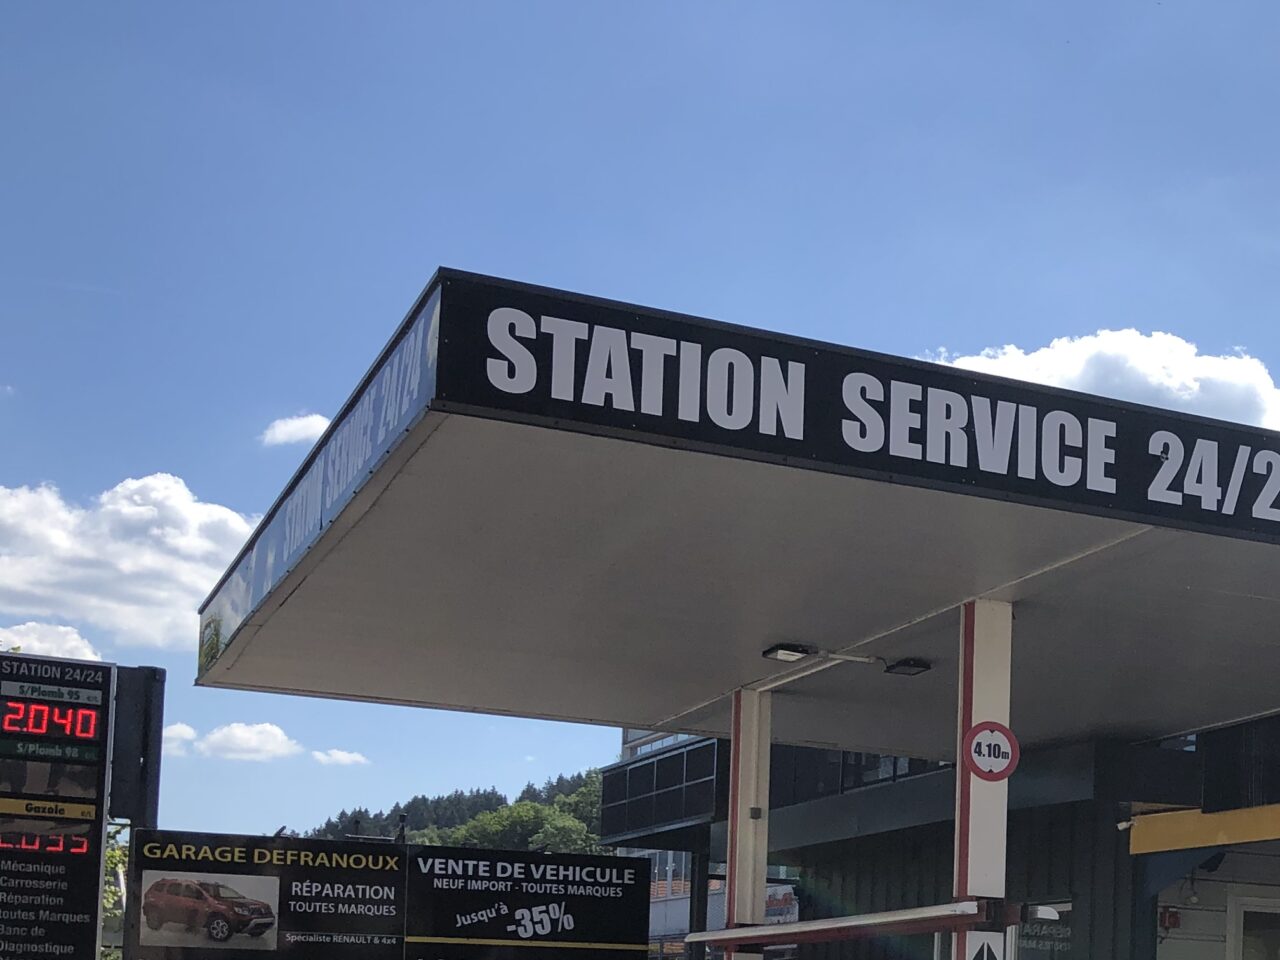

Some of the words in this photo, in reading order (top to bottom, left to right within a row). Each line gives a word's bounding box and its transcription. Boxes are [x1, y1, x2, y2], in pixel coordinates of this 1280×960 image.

[486, 306, 806, 441] STATION
[841, 372, 1117, 494] SERVICE
[1, 661, 61, 679] STATION
[64, 667, 103, 683] 24/24
[19, 685, 64, 699] S/Plomb
[67, 690, 80, 701] 95
[973, 741, 1010, 760] 4.10m
[25, 802, 65, 815] Gazole
[143, 842, 247, 864] GARAGE
[253, 848, 400, 871] DEFRANOUX
[0, 860, 66, 875] Mécanique
[417, 857, 491, 877] VENTE
[496, 862, 526, 879] DE
[530, 864, 636, 884] VEHICULE
[0, 876, 68, 890] Carrosserie
[291, 879, 396, 900] RÉPARATION
[433, 878, 465, 890] NEUF
[467, 879, 513, 892] IMPORT
[521, 882, 565, 895] TOUTES
[567, 884, 623, 898] MARQUES
[0, 891, 64, 906] Réparation
[38, 910, 91, 924] Marques
[289, 901, 335, 914] TOUTES
[337, 903, 397, 917] MARQUES
[506, 901, 575, 939] -35%
[30, 925, 46, 937] de
[373, 936, 380, 944] &
[381, 936, 397, 945] 4x4
